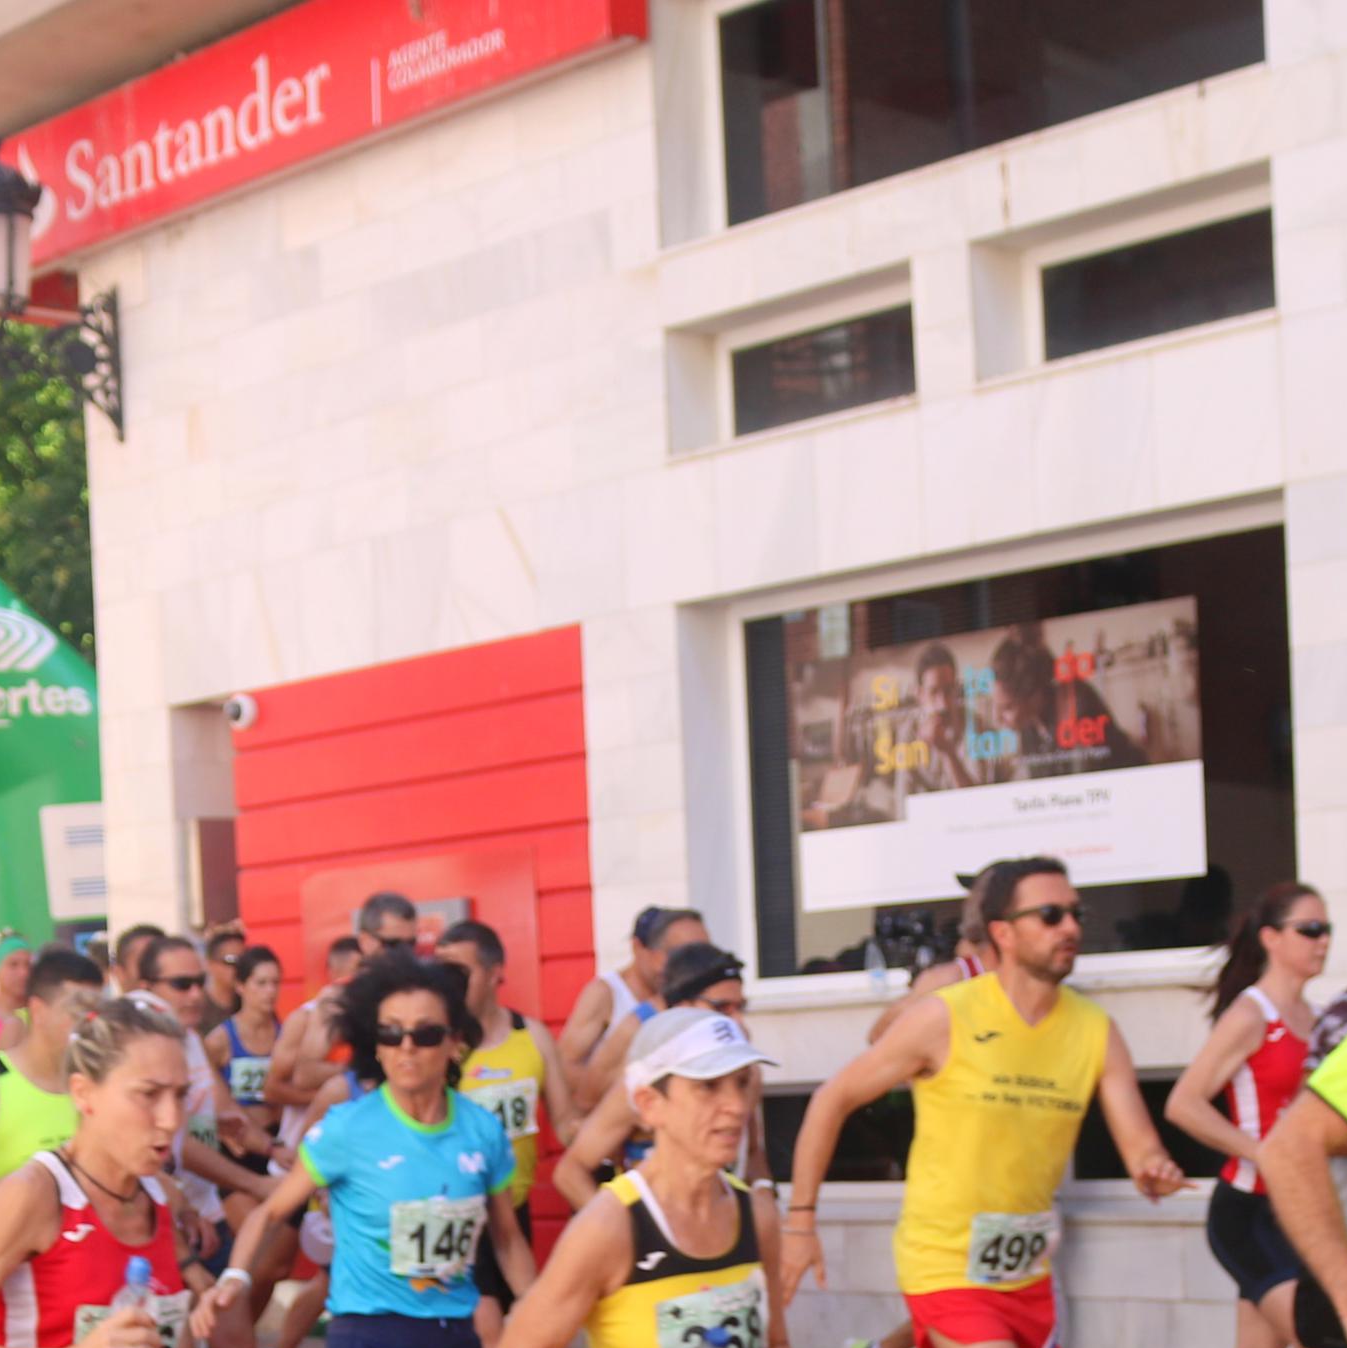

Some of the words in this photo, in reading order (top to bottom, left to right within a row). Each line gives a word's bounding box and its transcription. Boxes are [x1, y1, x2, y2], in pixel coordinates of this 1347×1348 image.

[64, 53, 332, 222] Santander
[873, 736, 931, 776] San
[1057, 712, 1112, 750] der
[409, 1217, 476, 1264] 146
[979, 1231, 1047, 1272] 499
